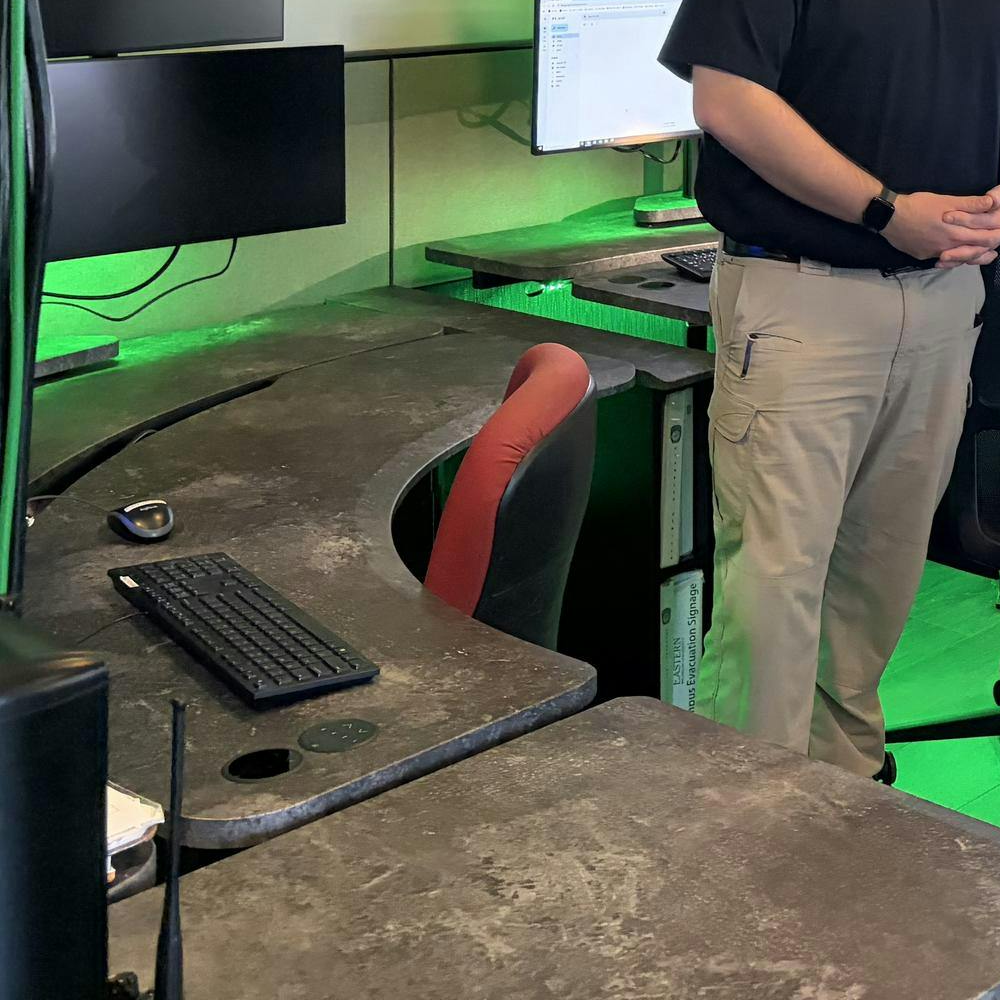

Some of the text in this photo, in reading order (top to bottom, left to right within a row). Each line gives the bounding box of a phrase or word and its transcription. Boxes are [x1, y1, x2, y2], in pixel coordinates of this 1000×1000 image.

[687, 583, 699, 626] Signage
[672, 636, 682, 686] EASTERN
[686, 627, 698, 686] Evacuation
